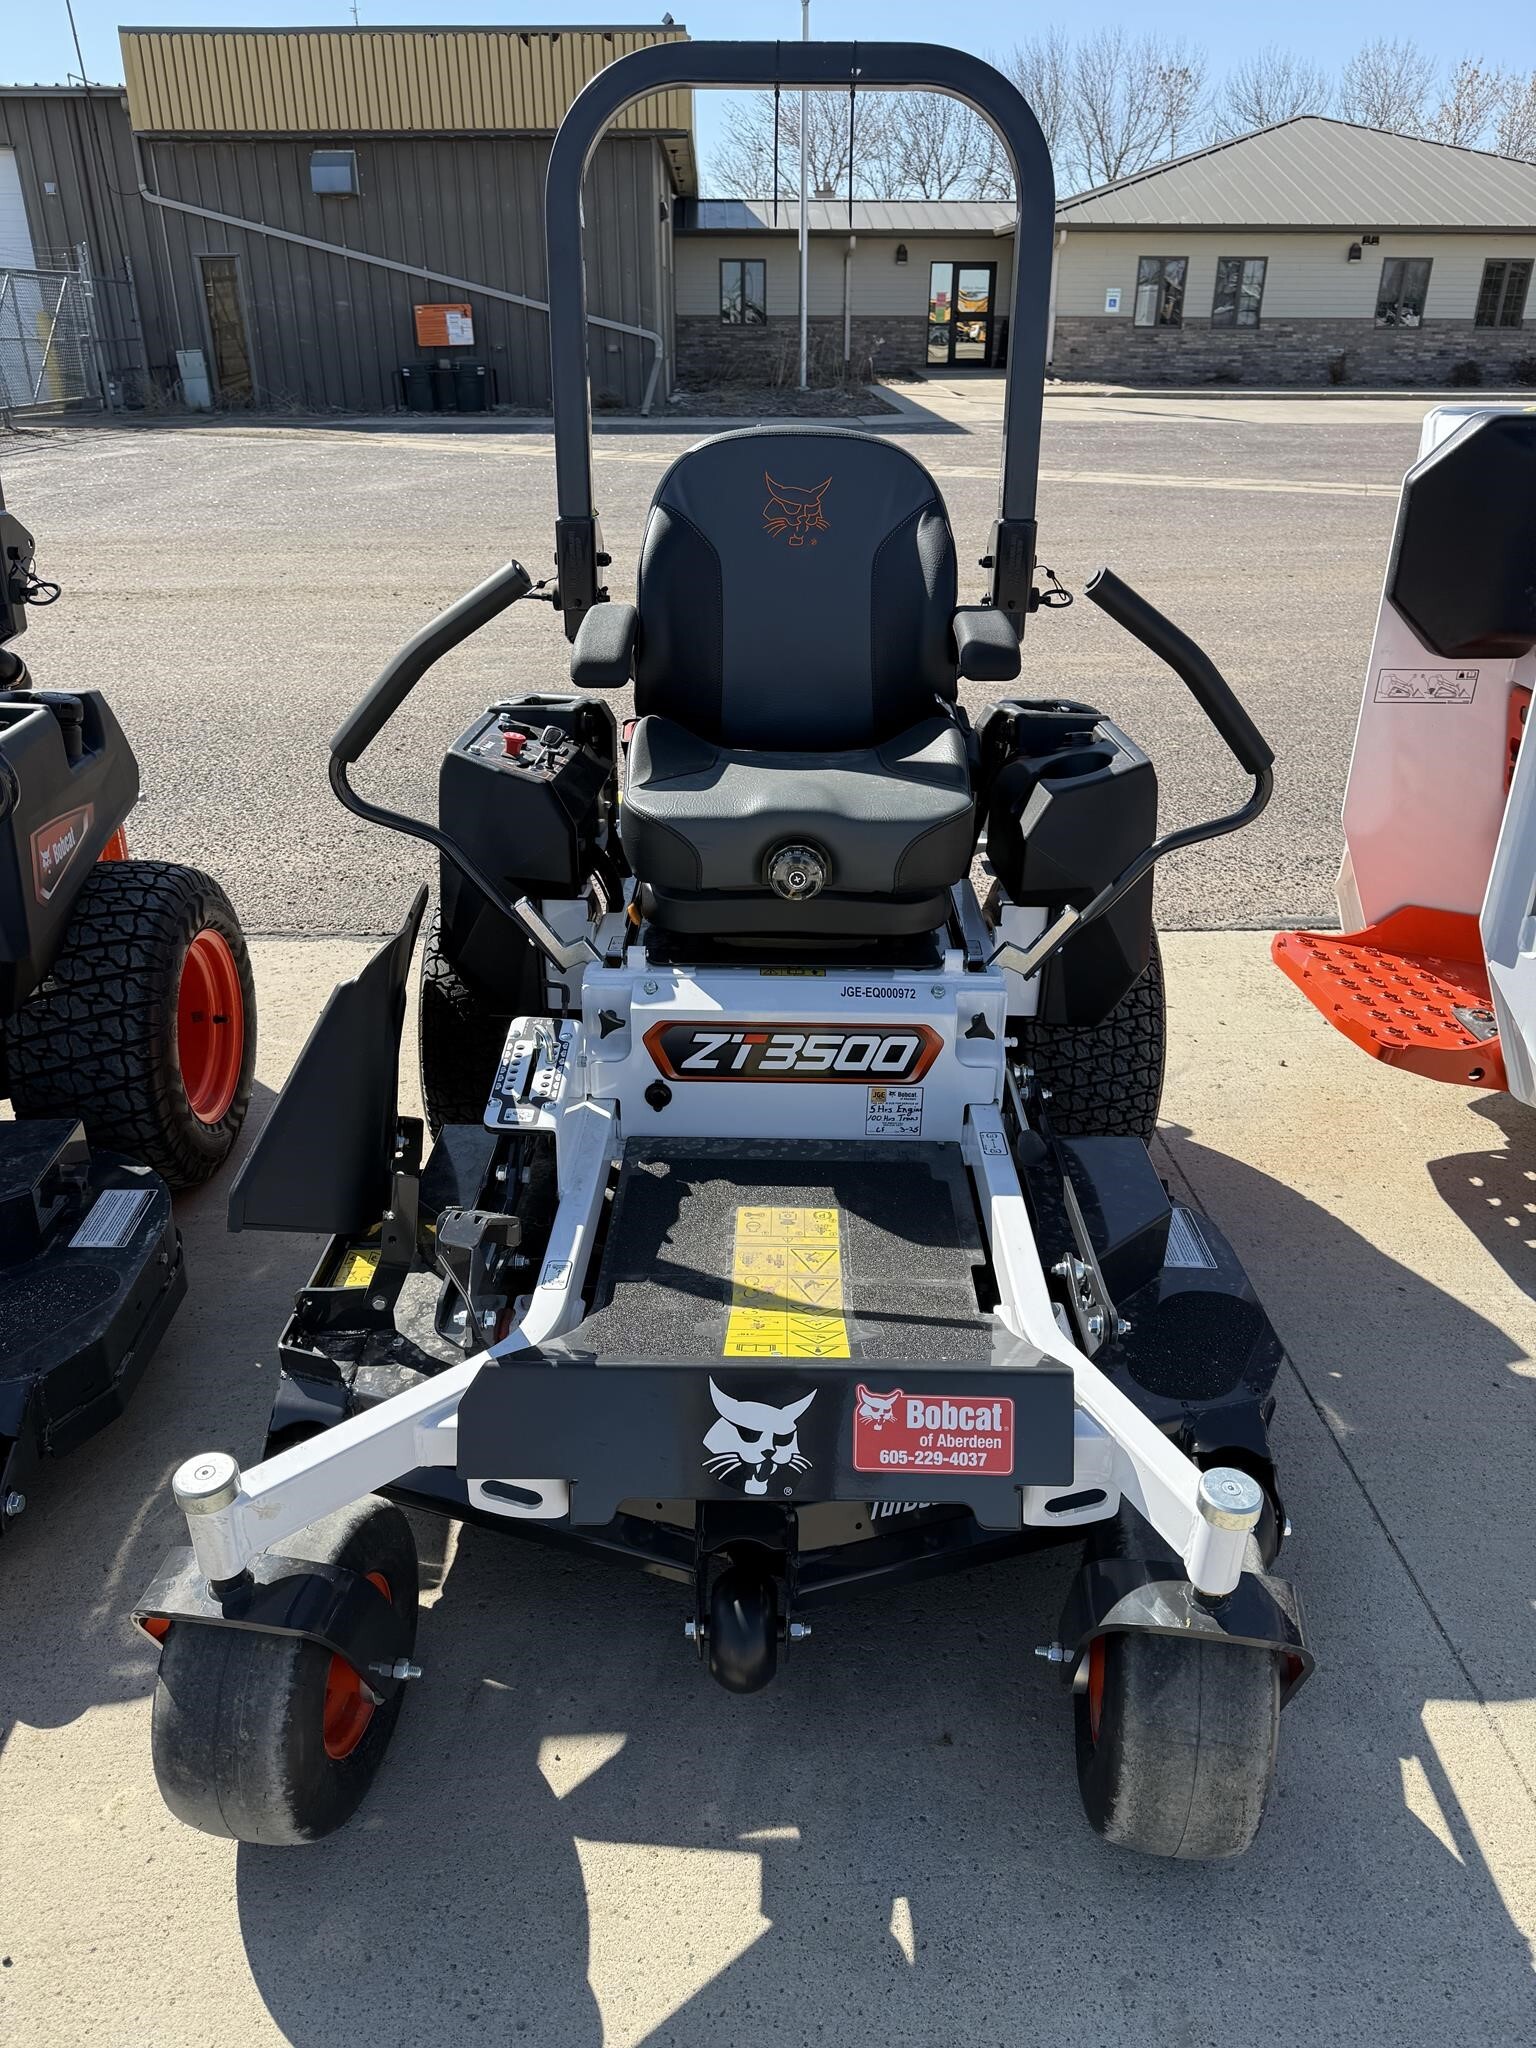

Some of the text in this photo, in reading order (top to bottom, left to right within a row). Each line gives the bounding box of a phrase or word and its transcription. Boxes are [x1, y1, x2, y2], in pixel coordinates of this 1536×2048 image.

[52, 826, 76, 865] Bobcat
[840, 986, 916, 999] JGE-EQ000972
[681, 1033, 920, 1072] ZT3500
[870, 1105, 876, 1113] 5
[878, 1105, 892, 1113] Hrs
[906, 1400, 1002, 1432] Bobcat
[919, 1433, 1002, 1449] of Aberdeen
[879, 1450, 988, 1467] 605-229-4037
